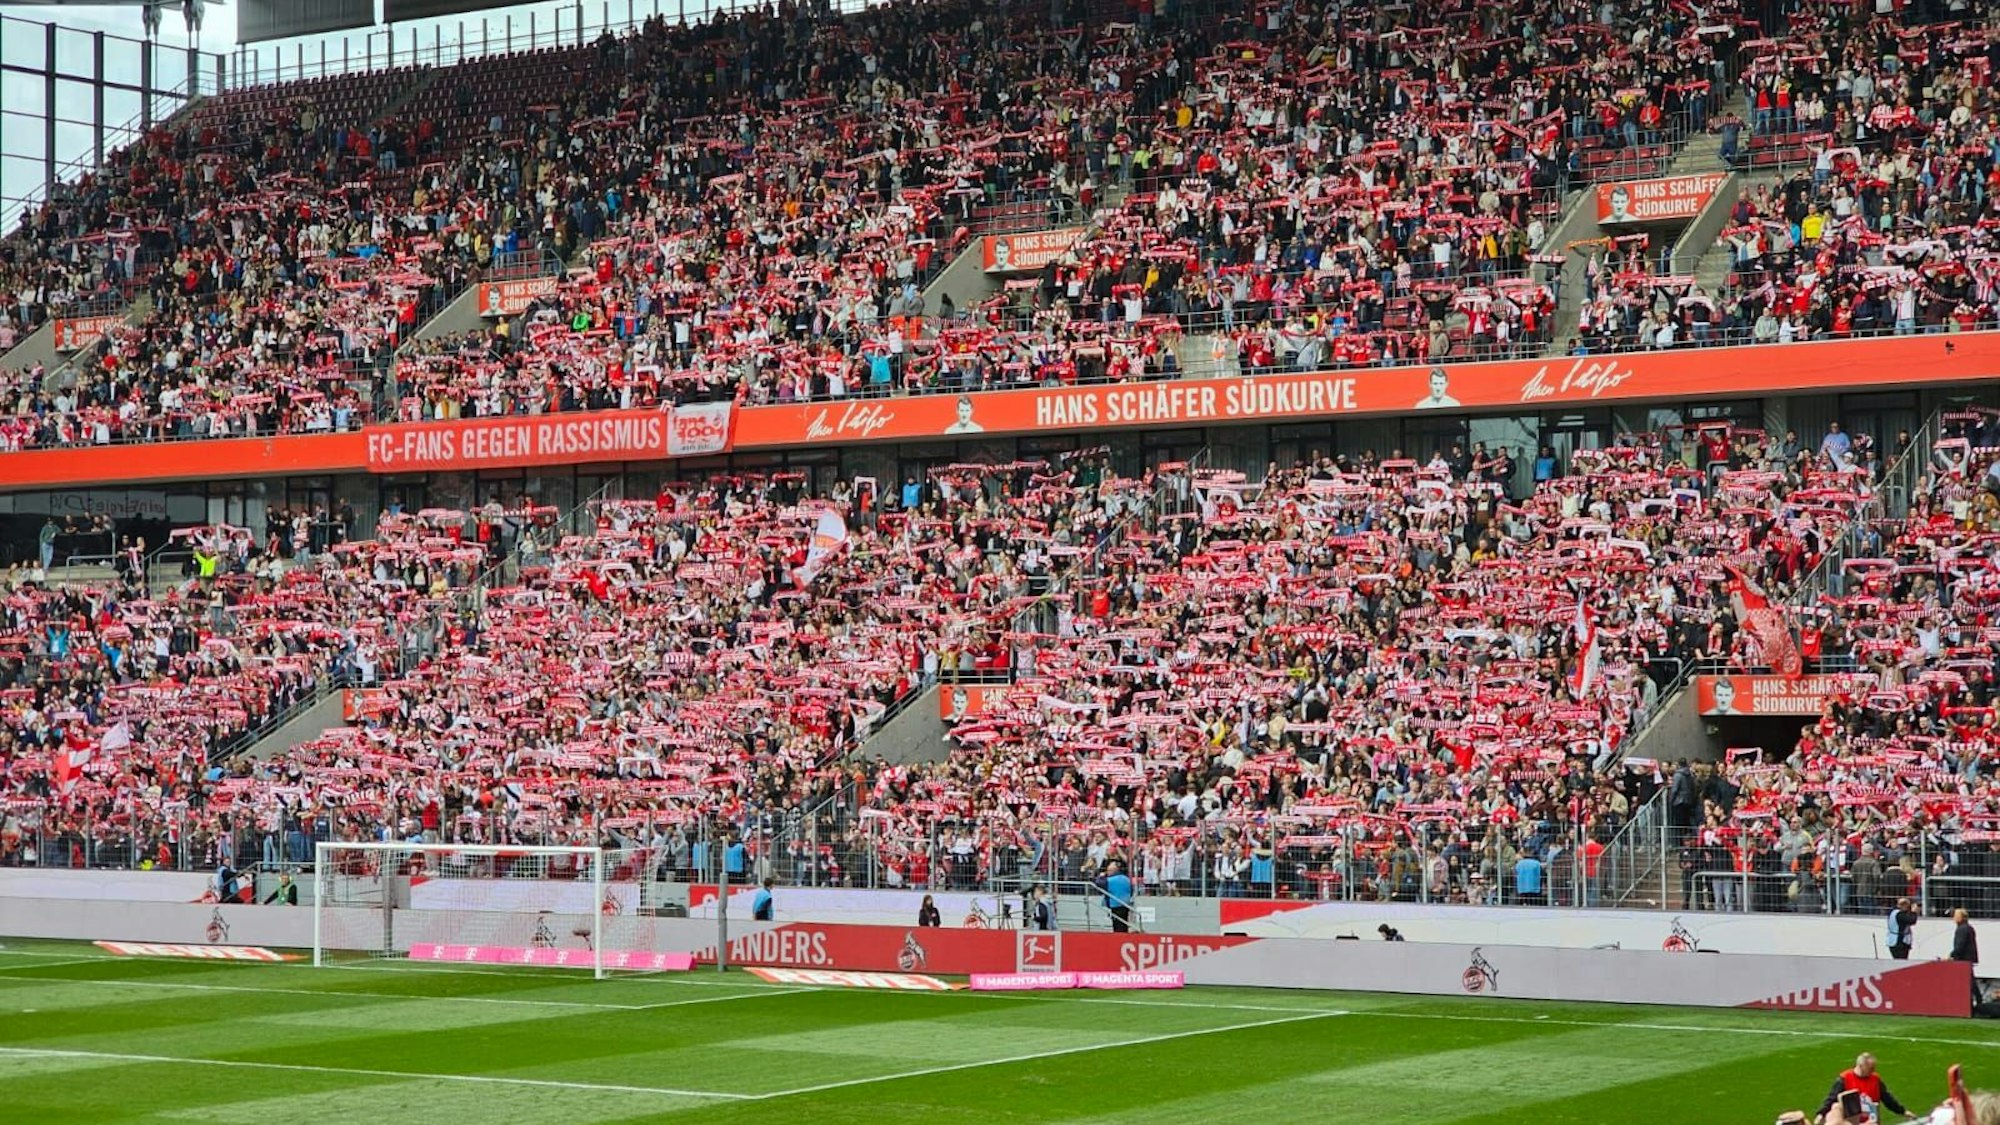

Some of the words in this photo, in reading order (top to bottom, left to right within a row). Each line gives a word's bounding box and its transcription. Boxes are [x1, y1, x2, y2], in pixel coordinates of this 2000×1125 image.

[1635, 183, 1666, 199] HANS
[1635, 197, 1698, 216] SÜDKURVE
[1014, 235, 1040, 250] HANS
[504, 283, 525, 297] HANS
[1037, 393, 1098, 425] HANS
[1107, 383, 1216, 421] SCHÄFER
[1226, 378, 1358, 415] SÜDKURVE
[369, 430, 455, 463] FC-FANS
[462, 425, 531, 459] GEGEN
[538, 416, 661, 454] RASSISMUS
[1753, 679, 1787, 695] HANS
[1753, 696, 1822, 712] SÜDKURVE
[987, 976, 1037, 985] MAGENTA
[1039, 975, 1072, 984] SPORT
[1093, 975, 1143, 984] MAGENTA
[1145, 974, 1179, 984] SPORT
